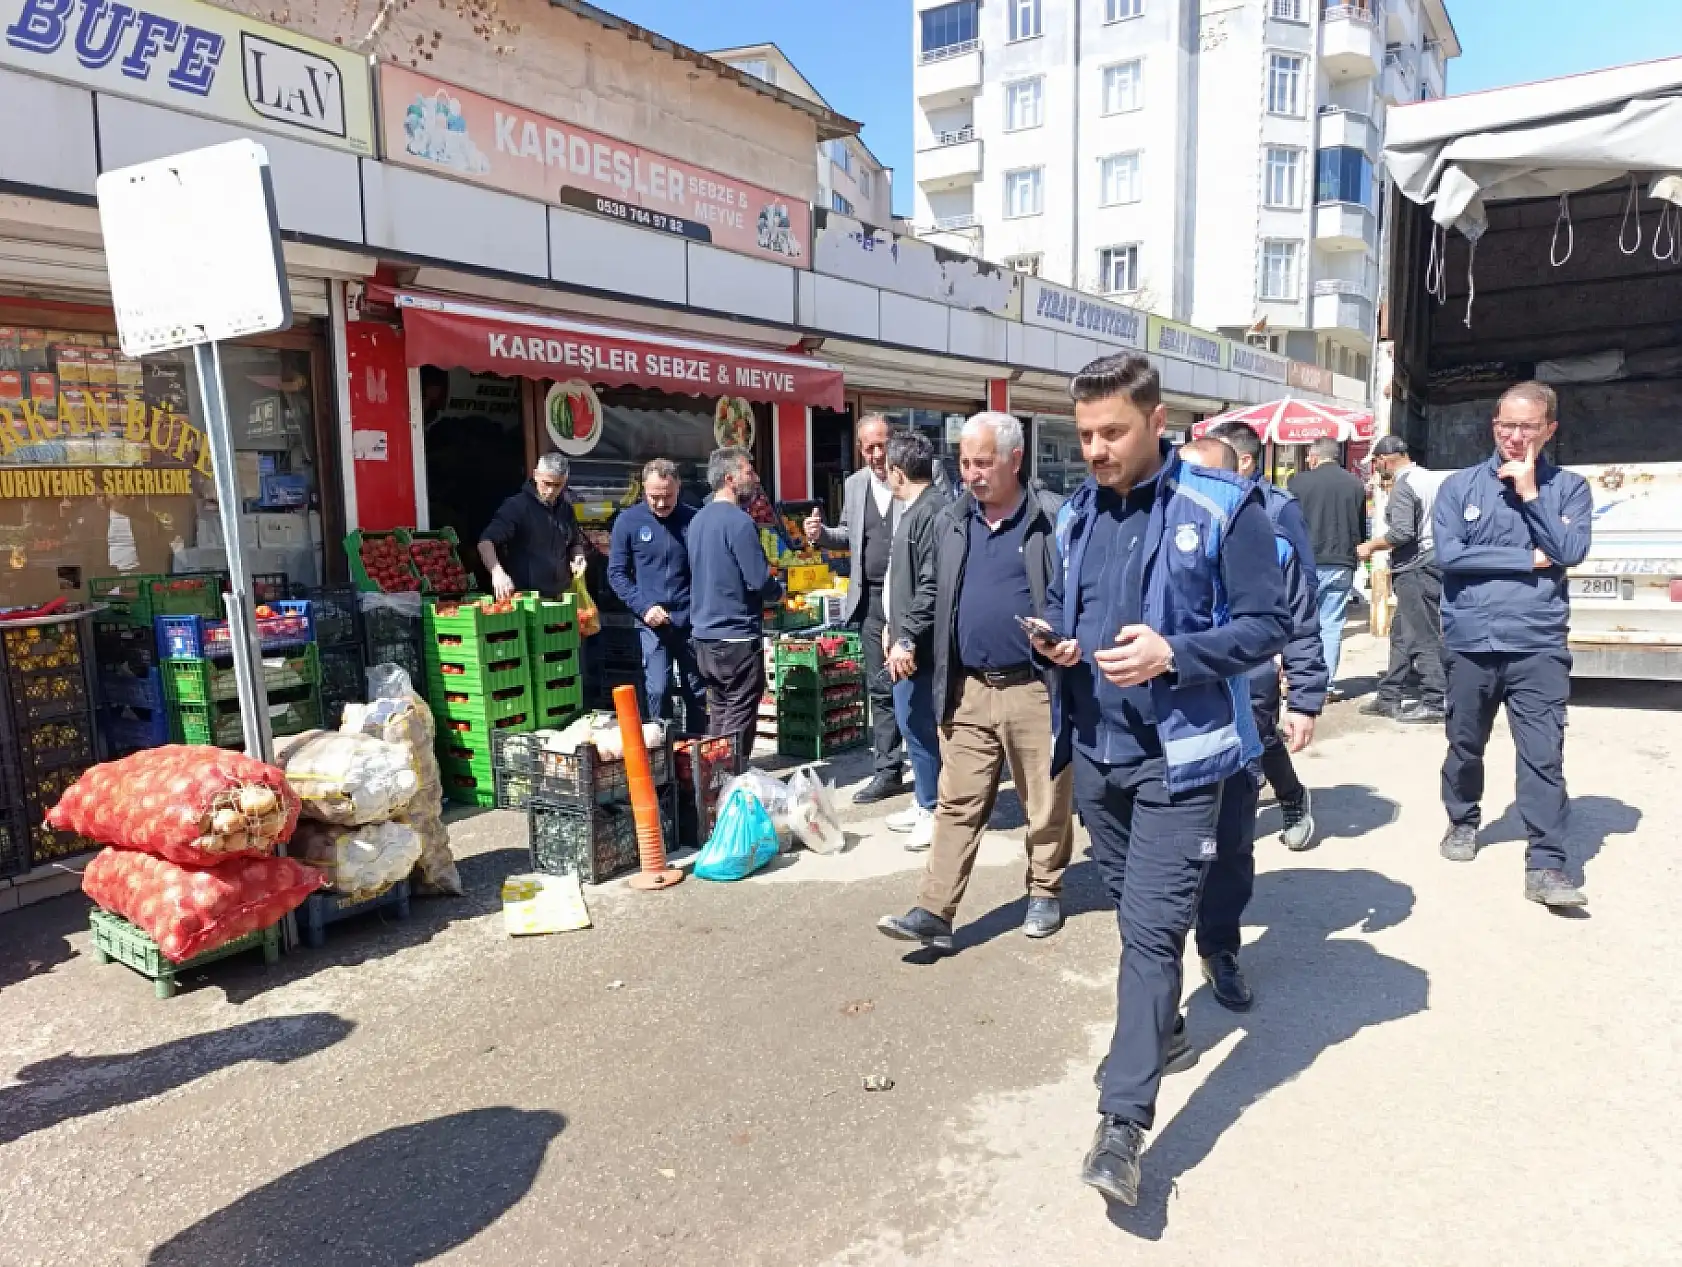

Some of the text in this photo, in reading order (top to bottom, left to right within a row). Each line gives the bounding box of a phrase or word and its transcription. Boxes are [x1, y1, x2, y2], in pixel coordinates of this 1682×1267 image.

[493, 111, 686, 204] KARDEŞLER
[688, 176, 734, 204] SEBZE
[694, 200, 744, 229] MEYVE
[488, 332, 795, 393] KARDEŞLER SEBZE & MEYVE
